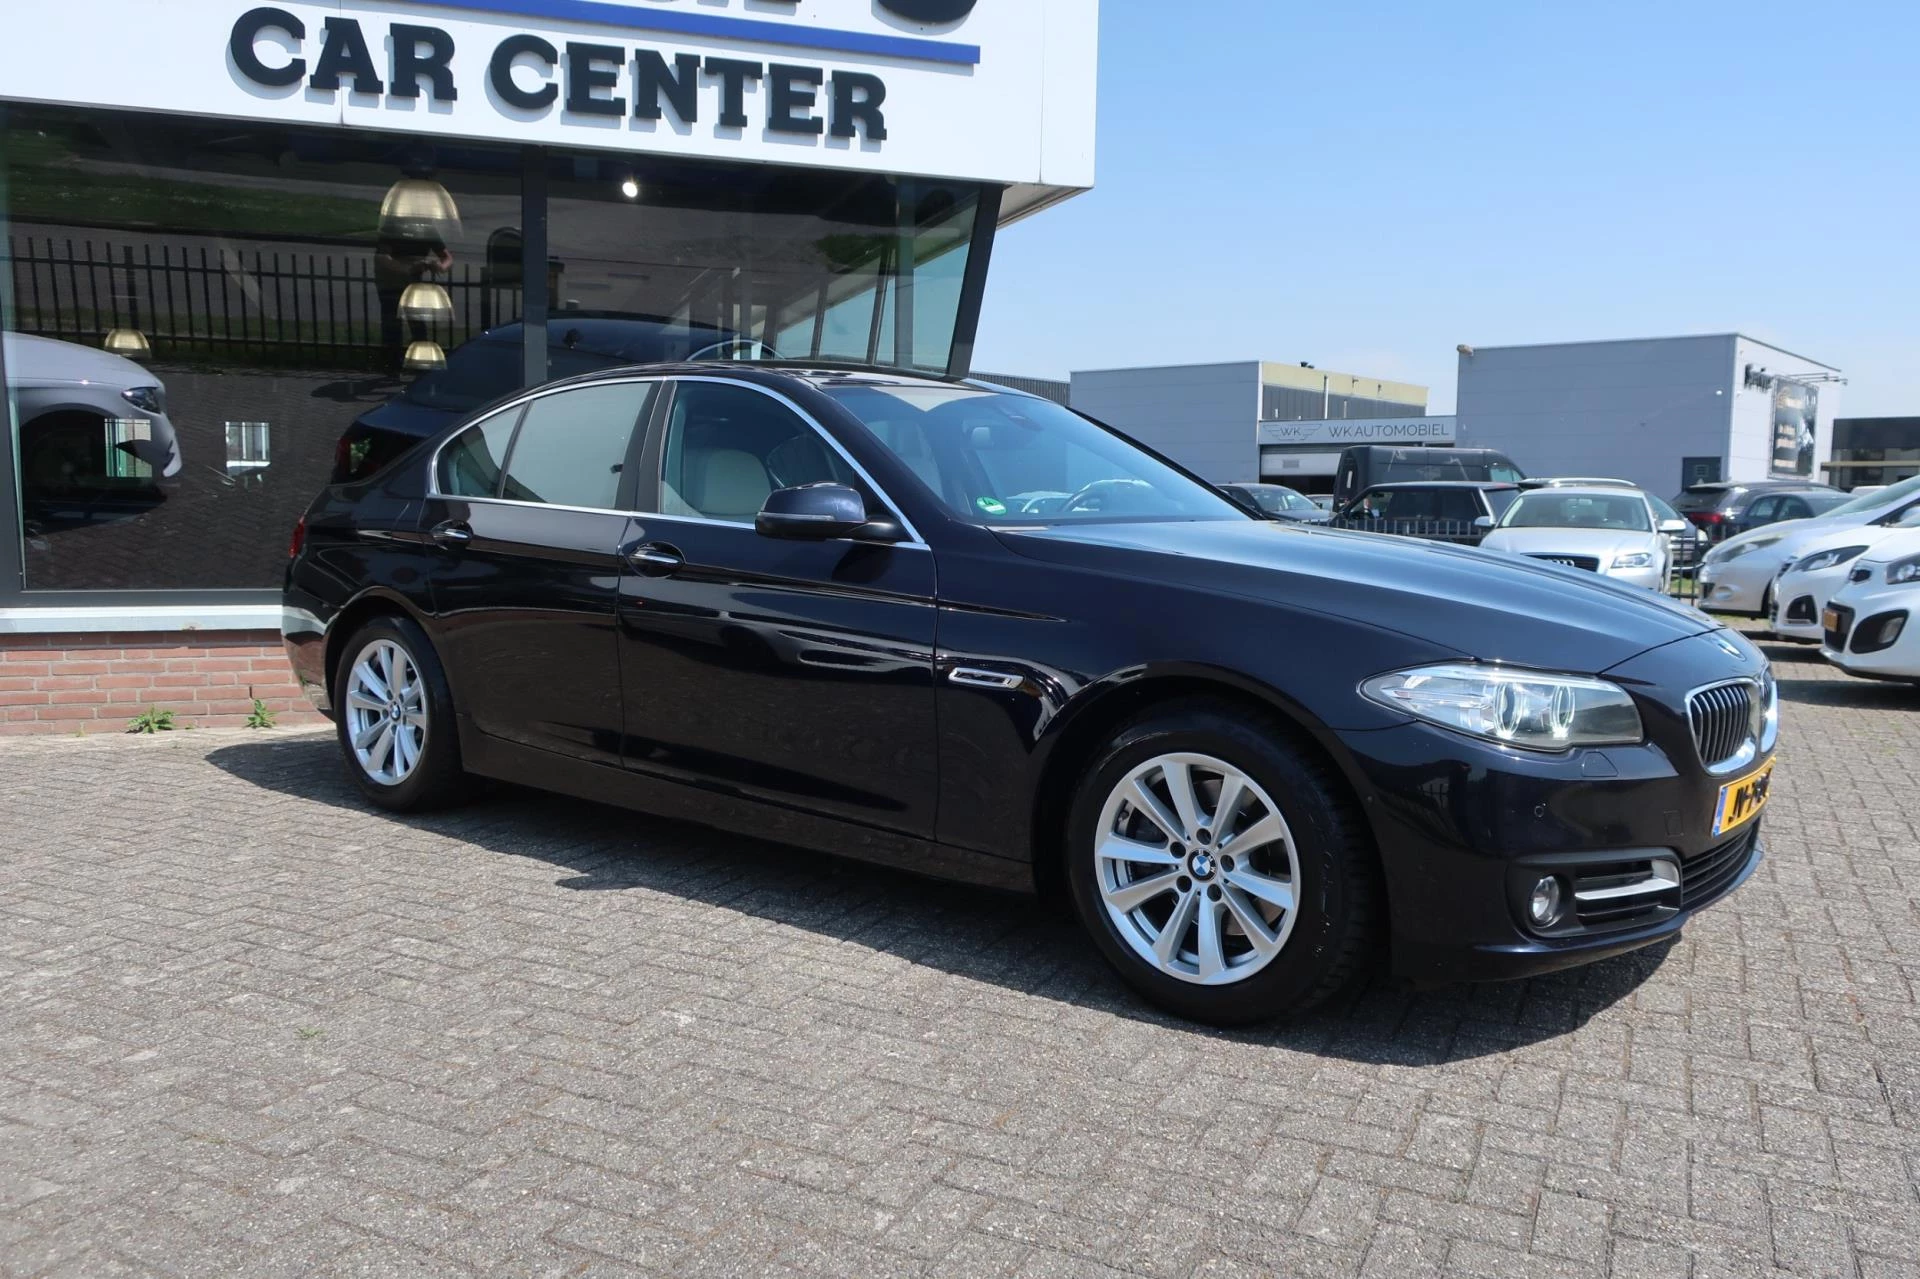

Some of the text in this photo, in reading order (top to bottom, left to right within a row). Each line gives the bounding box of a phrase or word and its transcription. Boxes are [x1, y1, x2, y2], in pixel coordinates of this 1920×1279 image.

[229, 7, 888, 142] CAR CENTER
[1280, 426, 1301, 437] WK
[1329, 423, 1450, 438] WK AUTOMOBIEL
